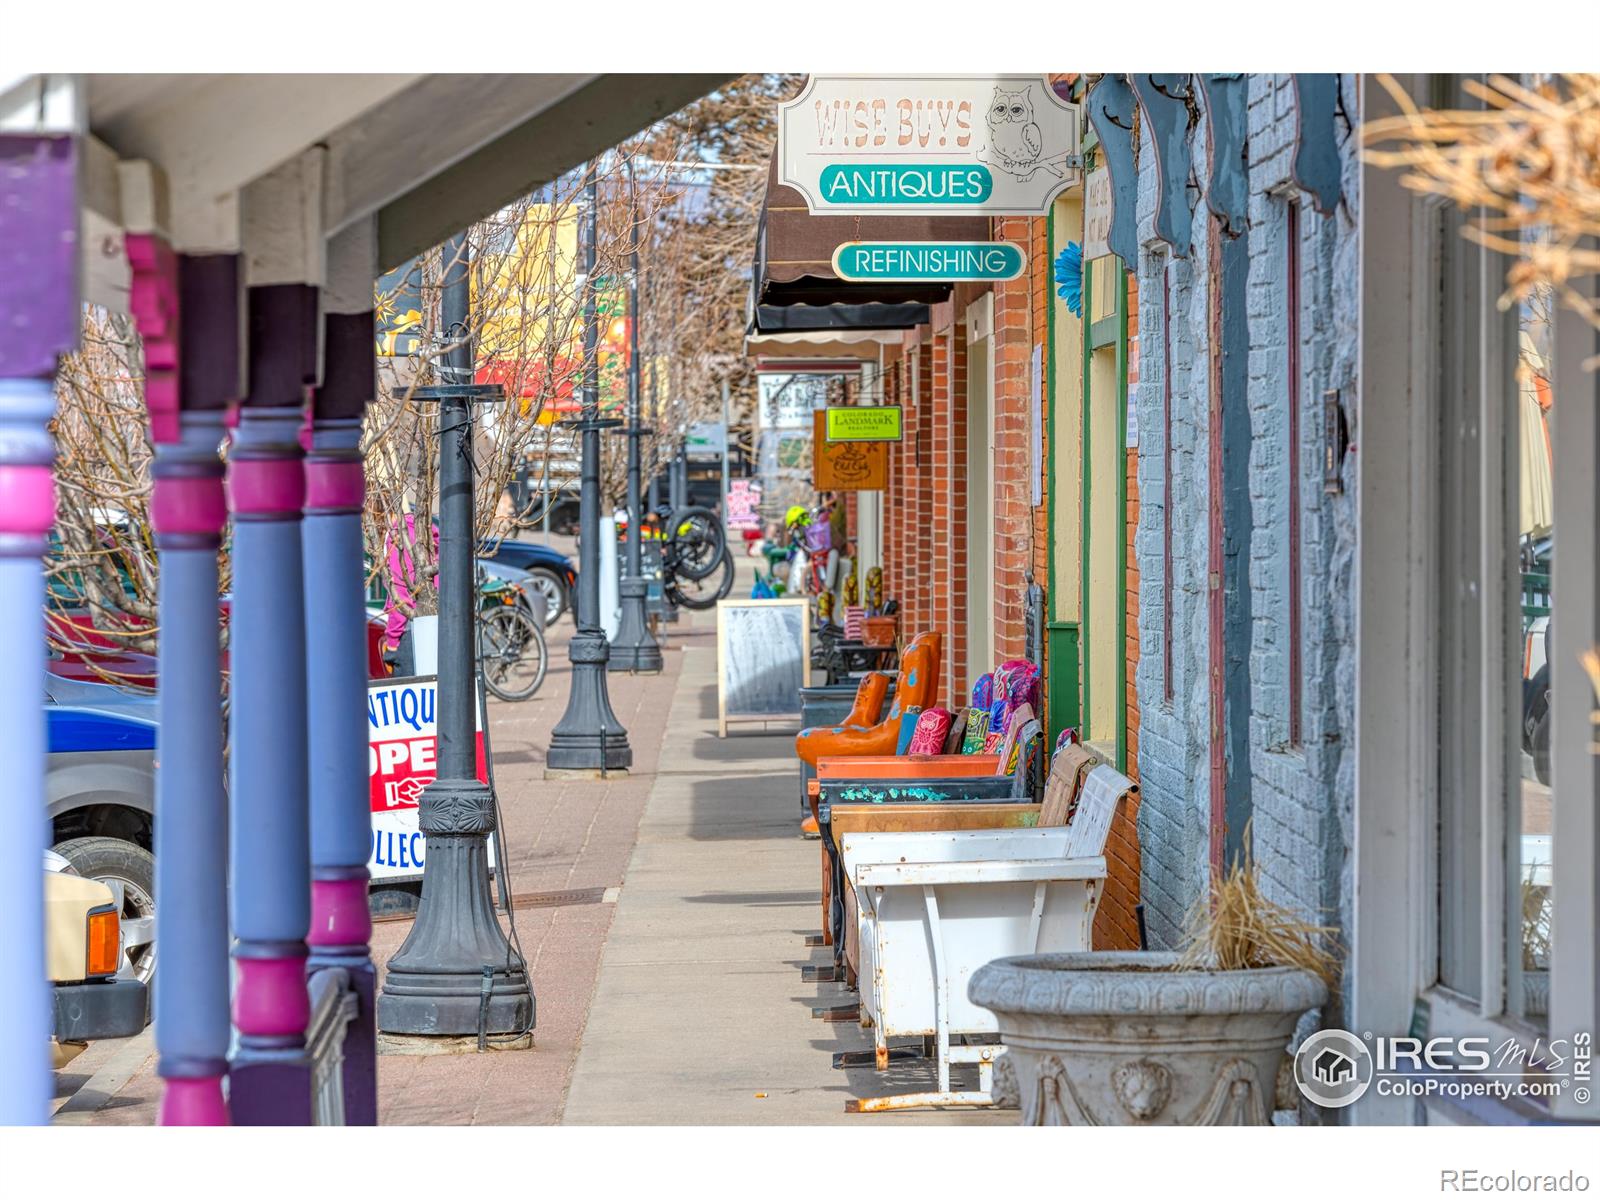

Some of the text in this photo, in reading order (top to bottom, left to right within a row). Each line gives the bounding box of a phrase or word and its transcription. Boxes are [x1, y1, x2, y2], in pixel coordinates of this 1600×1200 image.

[815, 99, 972, 148] WISE BUYS
[828, 170, 983, 199] ANTIQUES
[855, 250, 1007, 273] REFINISHING
[834, 415, 894, 426] LANDMARK
[368, 688, 435, 732] NTIQU
